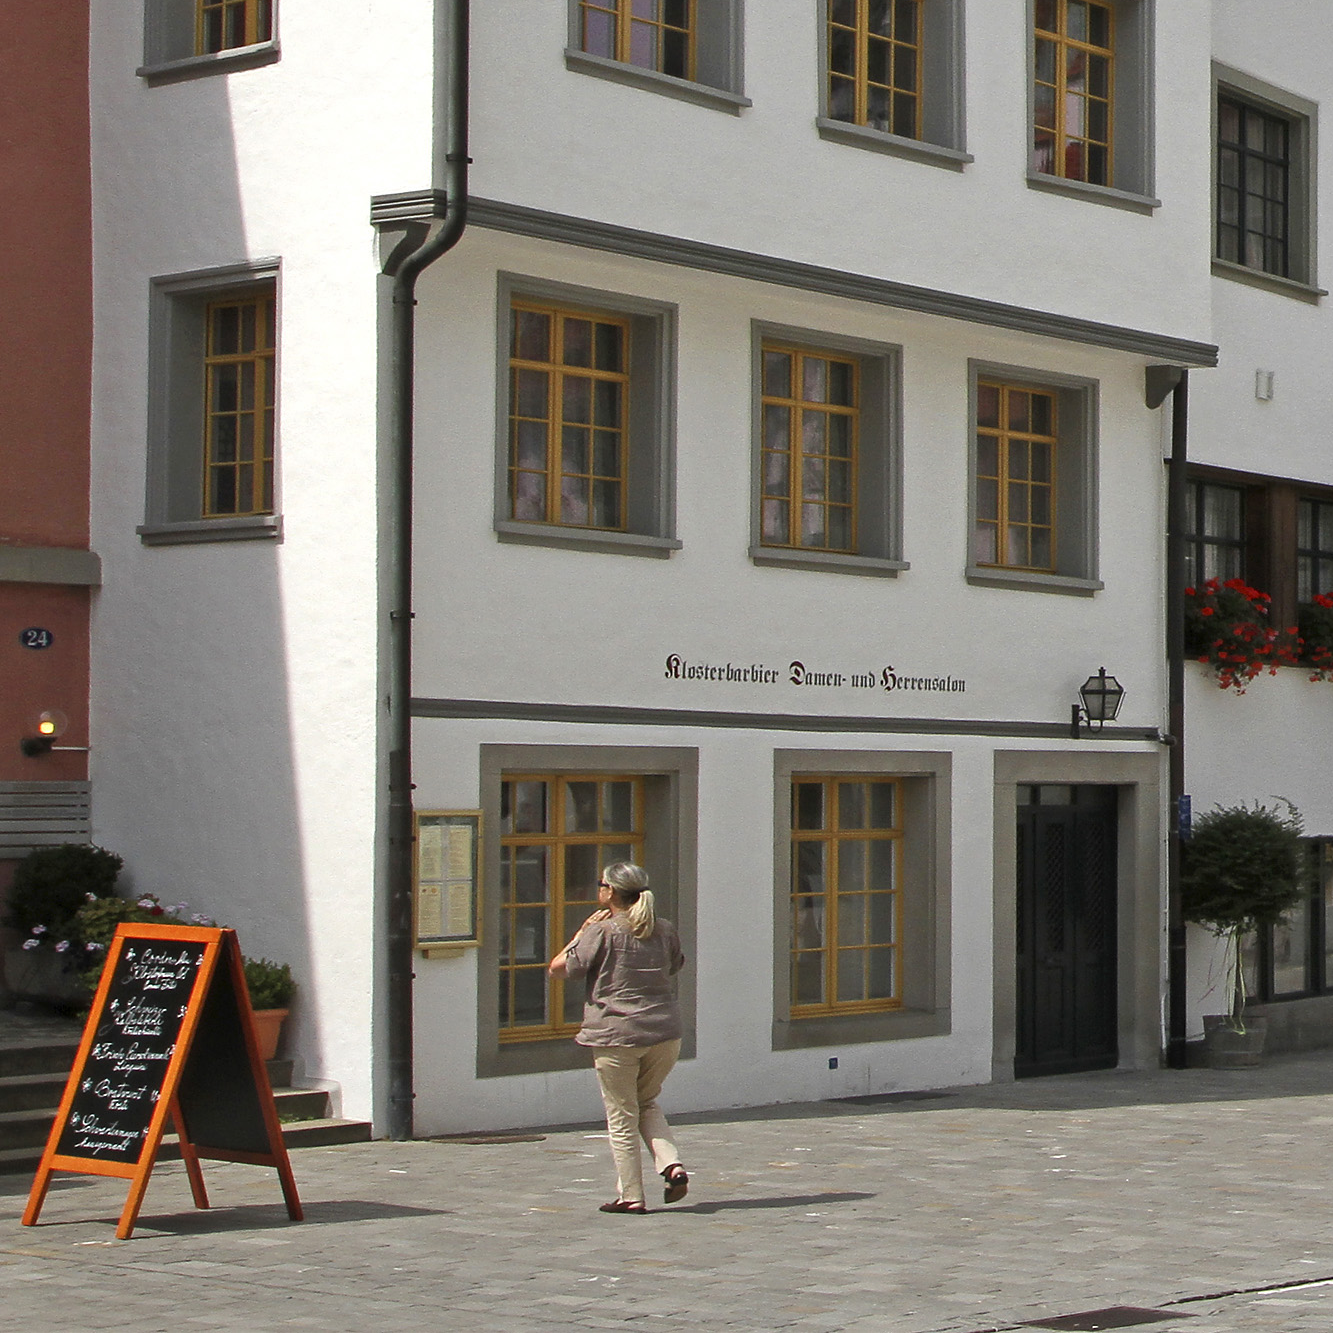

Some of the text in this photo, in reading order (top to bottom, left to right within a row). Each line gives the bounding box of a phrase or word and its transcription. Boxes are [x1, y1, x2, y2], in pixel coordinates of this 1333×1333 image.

[27, 630, 48, 646] 24
[664, 653, 966, 693] Klosterbarbier Damen- und Herrensalon
